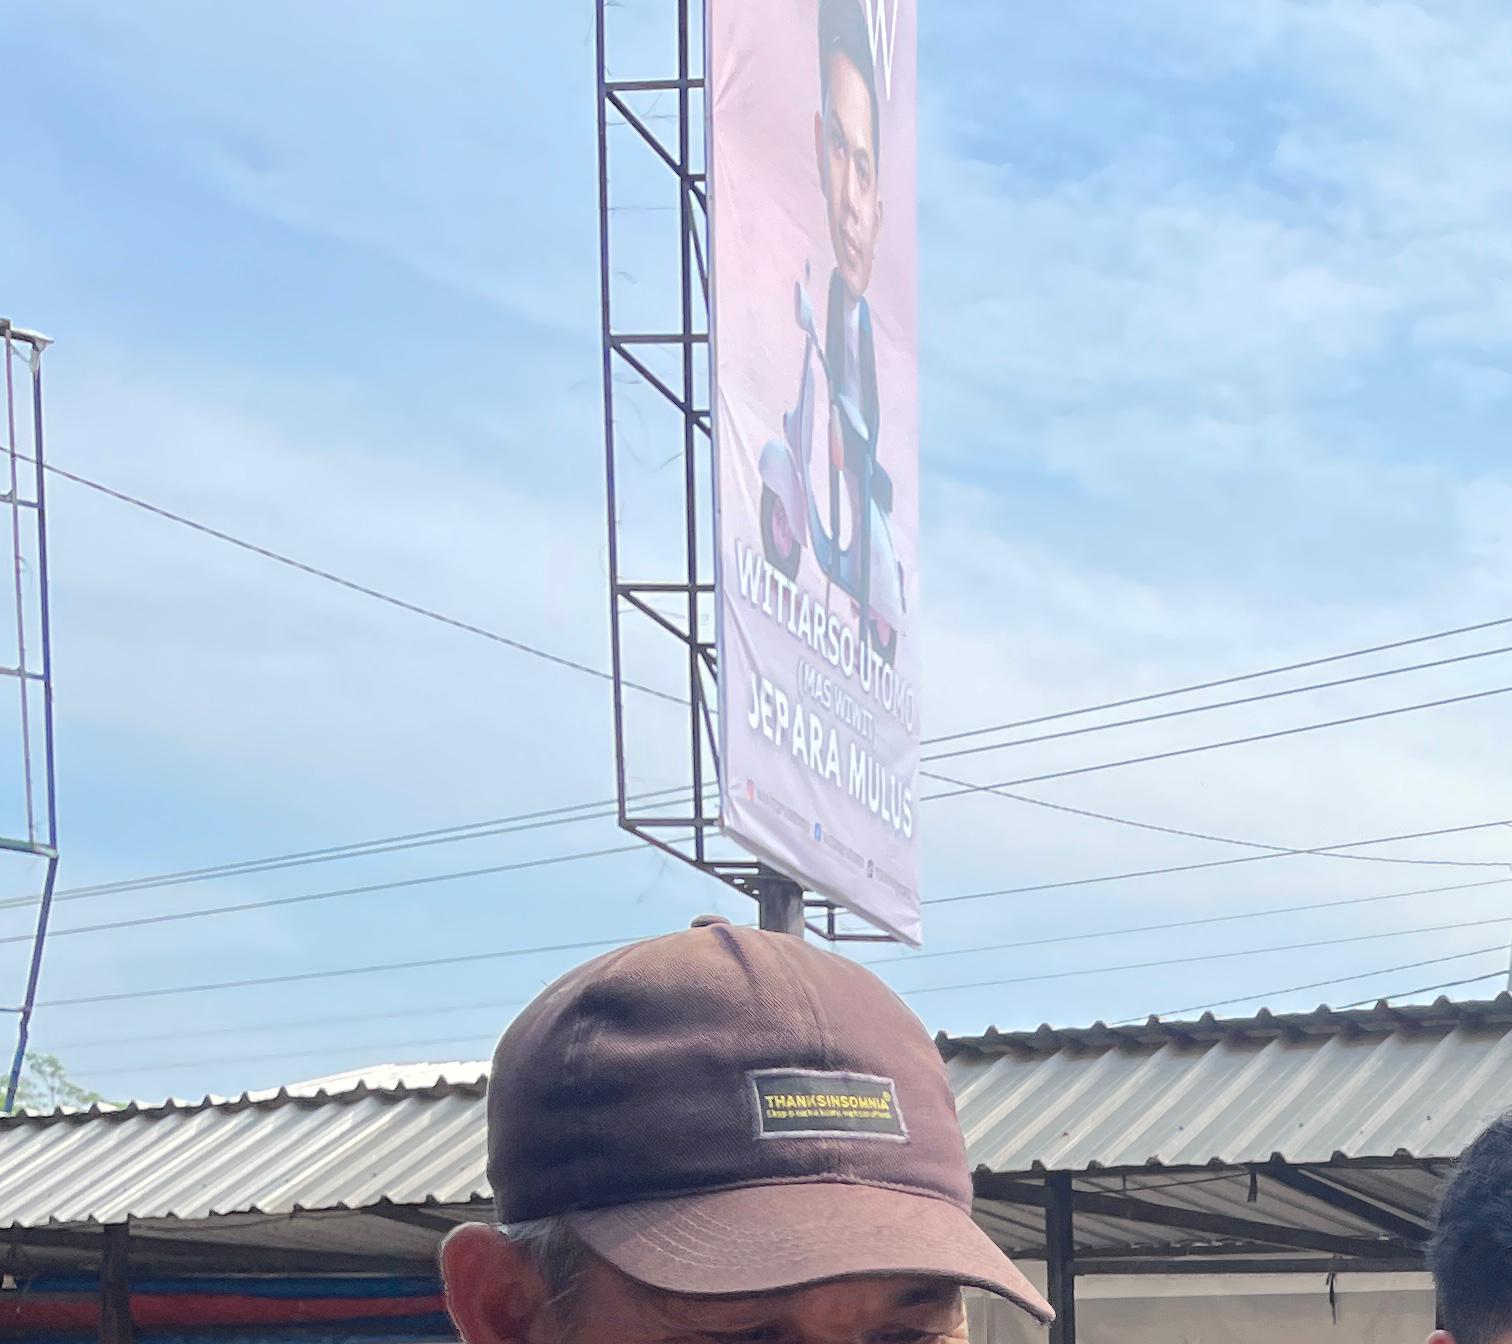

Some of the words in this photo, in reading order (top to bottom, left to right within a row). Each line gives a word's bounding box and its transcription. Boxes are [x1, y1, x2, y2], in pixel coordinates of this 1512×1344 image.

[735, 539, 854, 677] WITIARSO
[859, 630, 914, 732] UTOMO
[748, 673, 841, 787] JEPARA
[848, 742, 913, 839] MULUS
